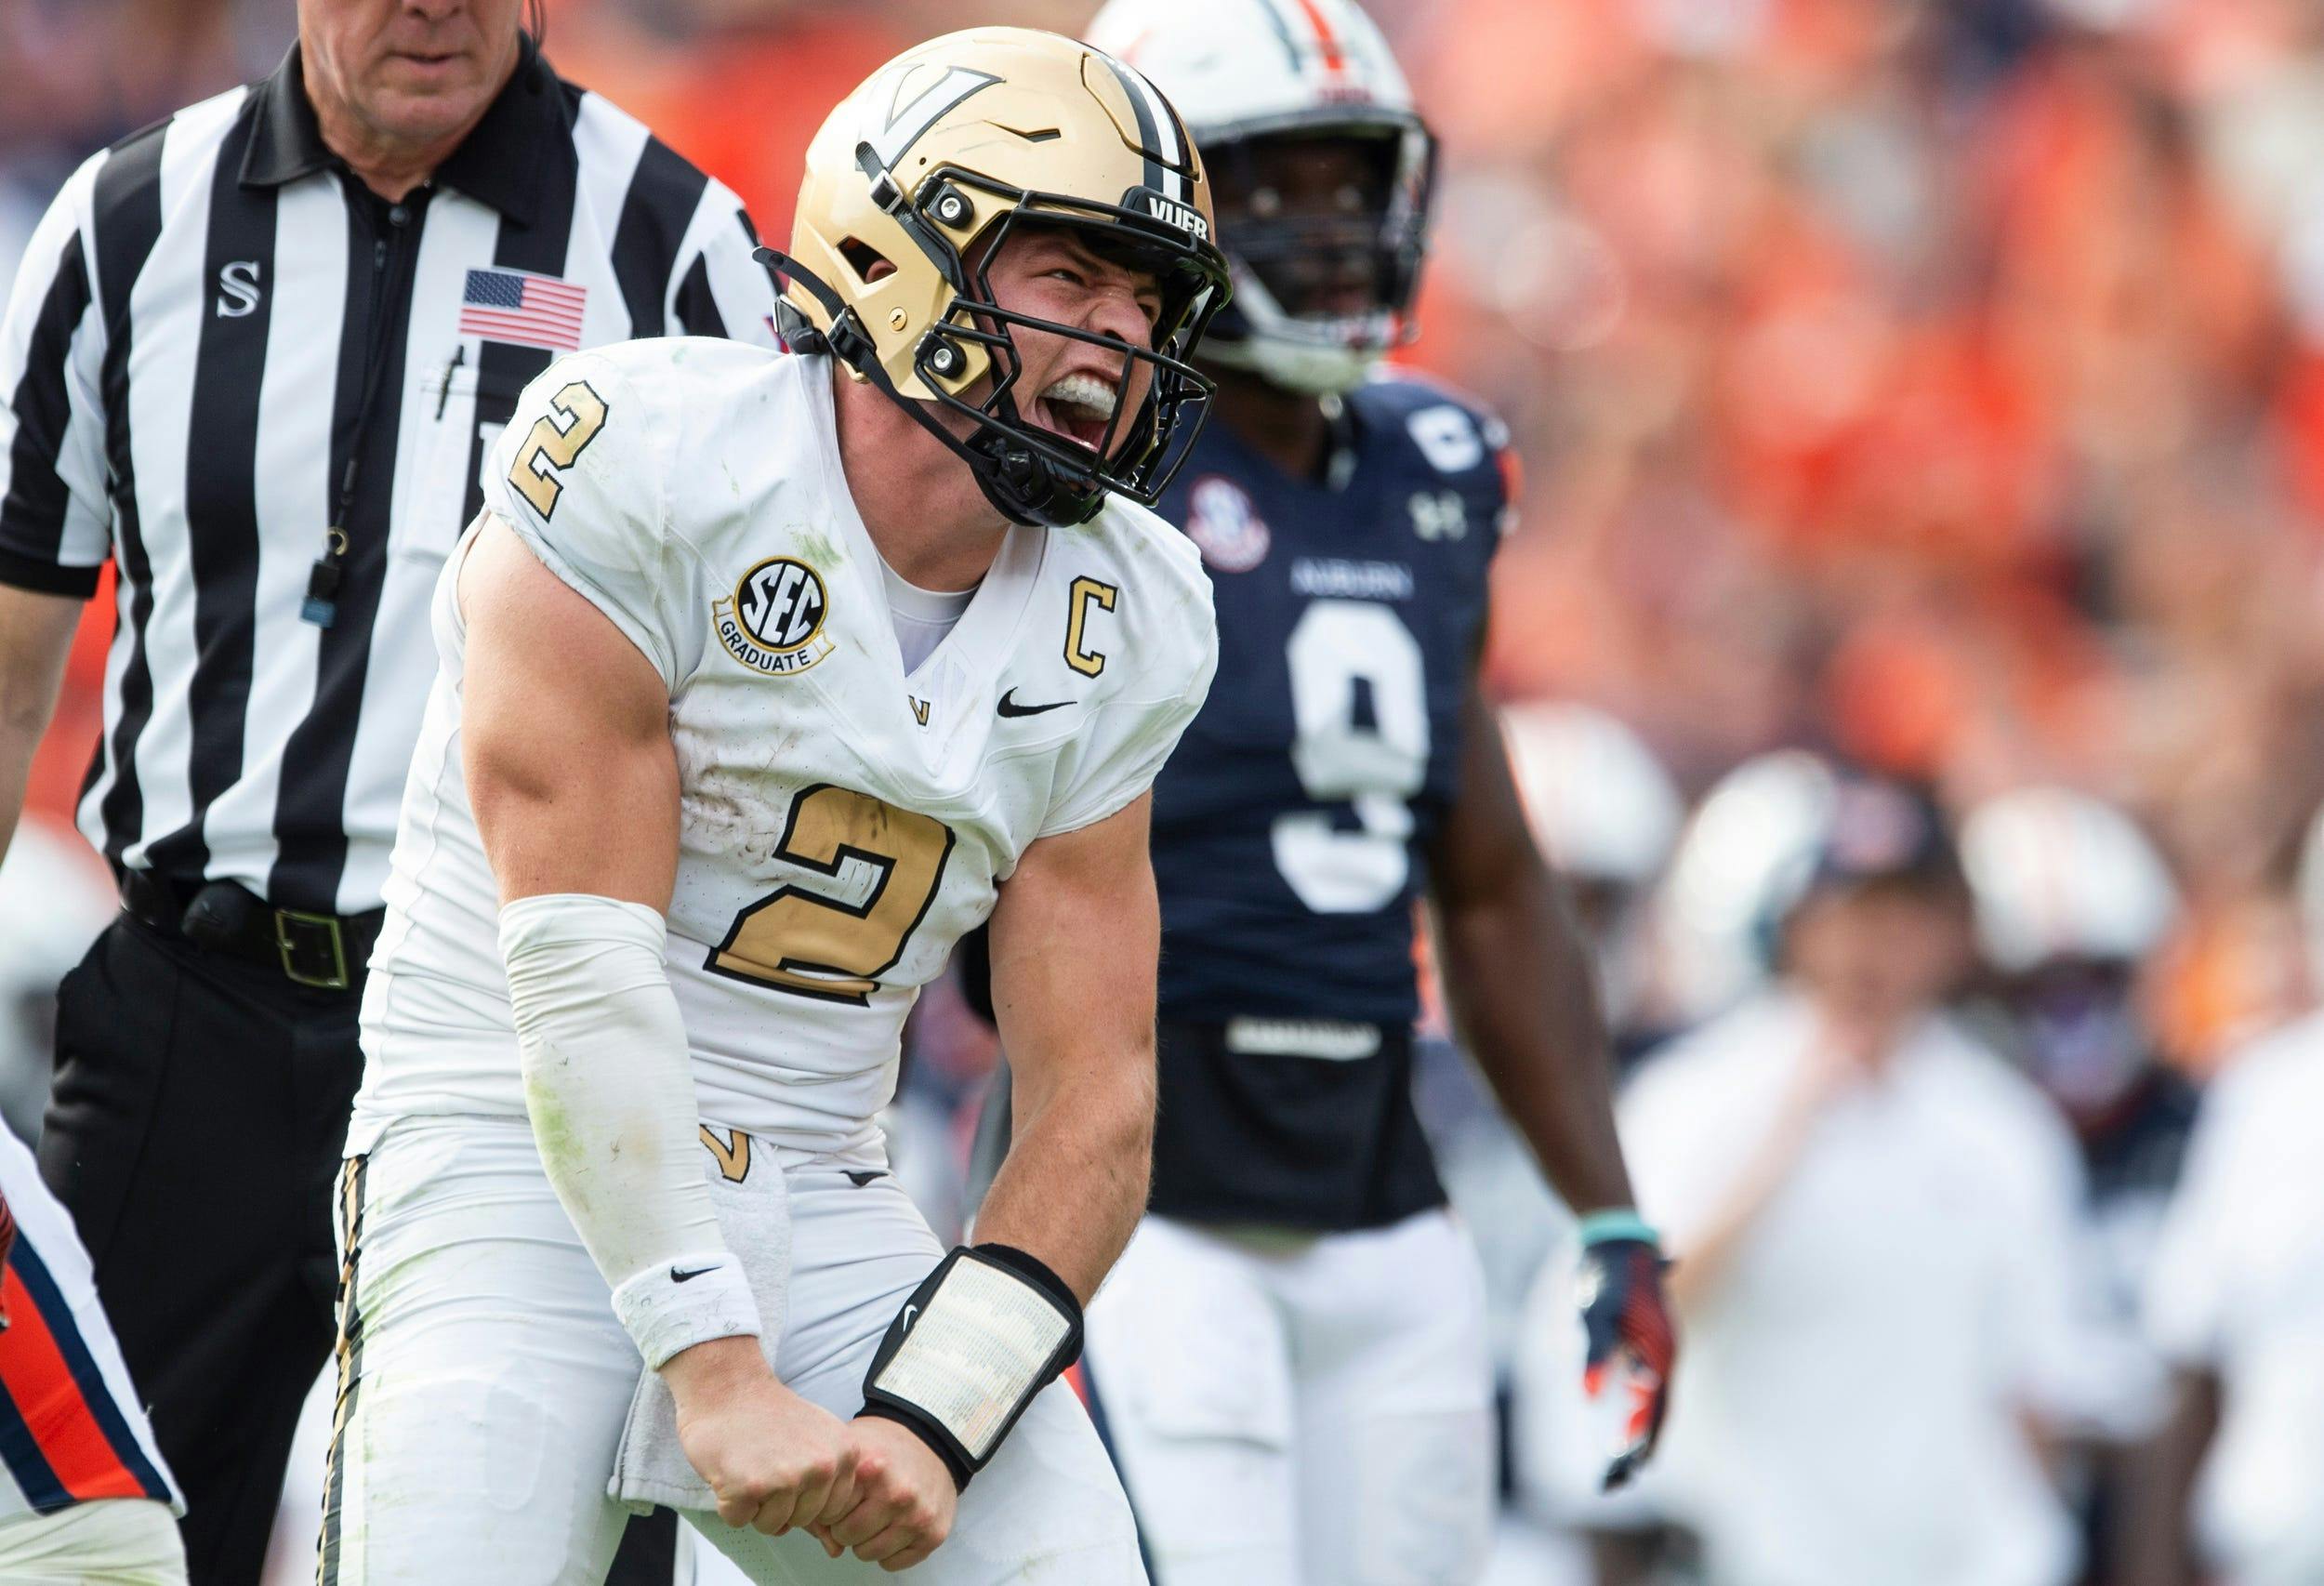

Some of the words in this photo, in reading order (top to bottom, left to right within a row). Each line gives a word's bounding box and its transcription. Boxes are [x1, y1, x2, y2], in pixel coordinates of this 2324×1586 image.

[217, 261, 260, 318] S
[508, 379, 609, 523] 2
[720, 620, 811, 671] GRADUATE
[742, 562, 821, 645] SEC
[1063, 575, 1117, 679] C
[908, 694, 931, 727] V
[1270, 599, 1432, 914] 9
[703, 783, 956, 1008] 2
